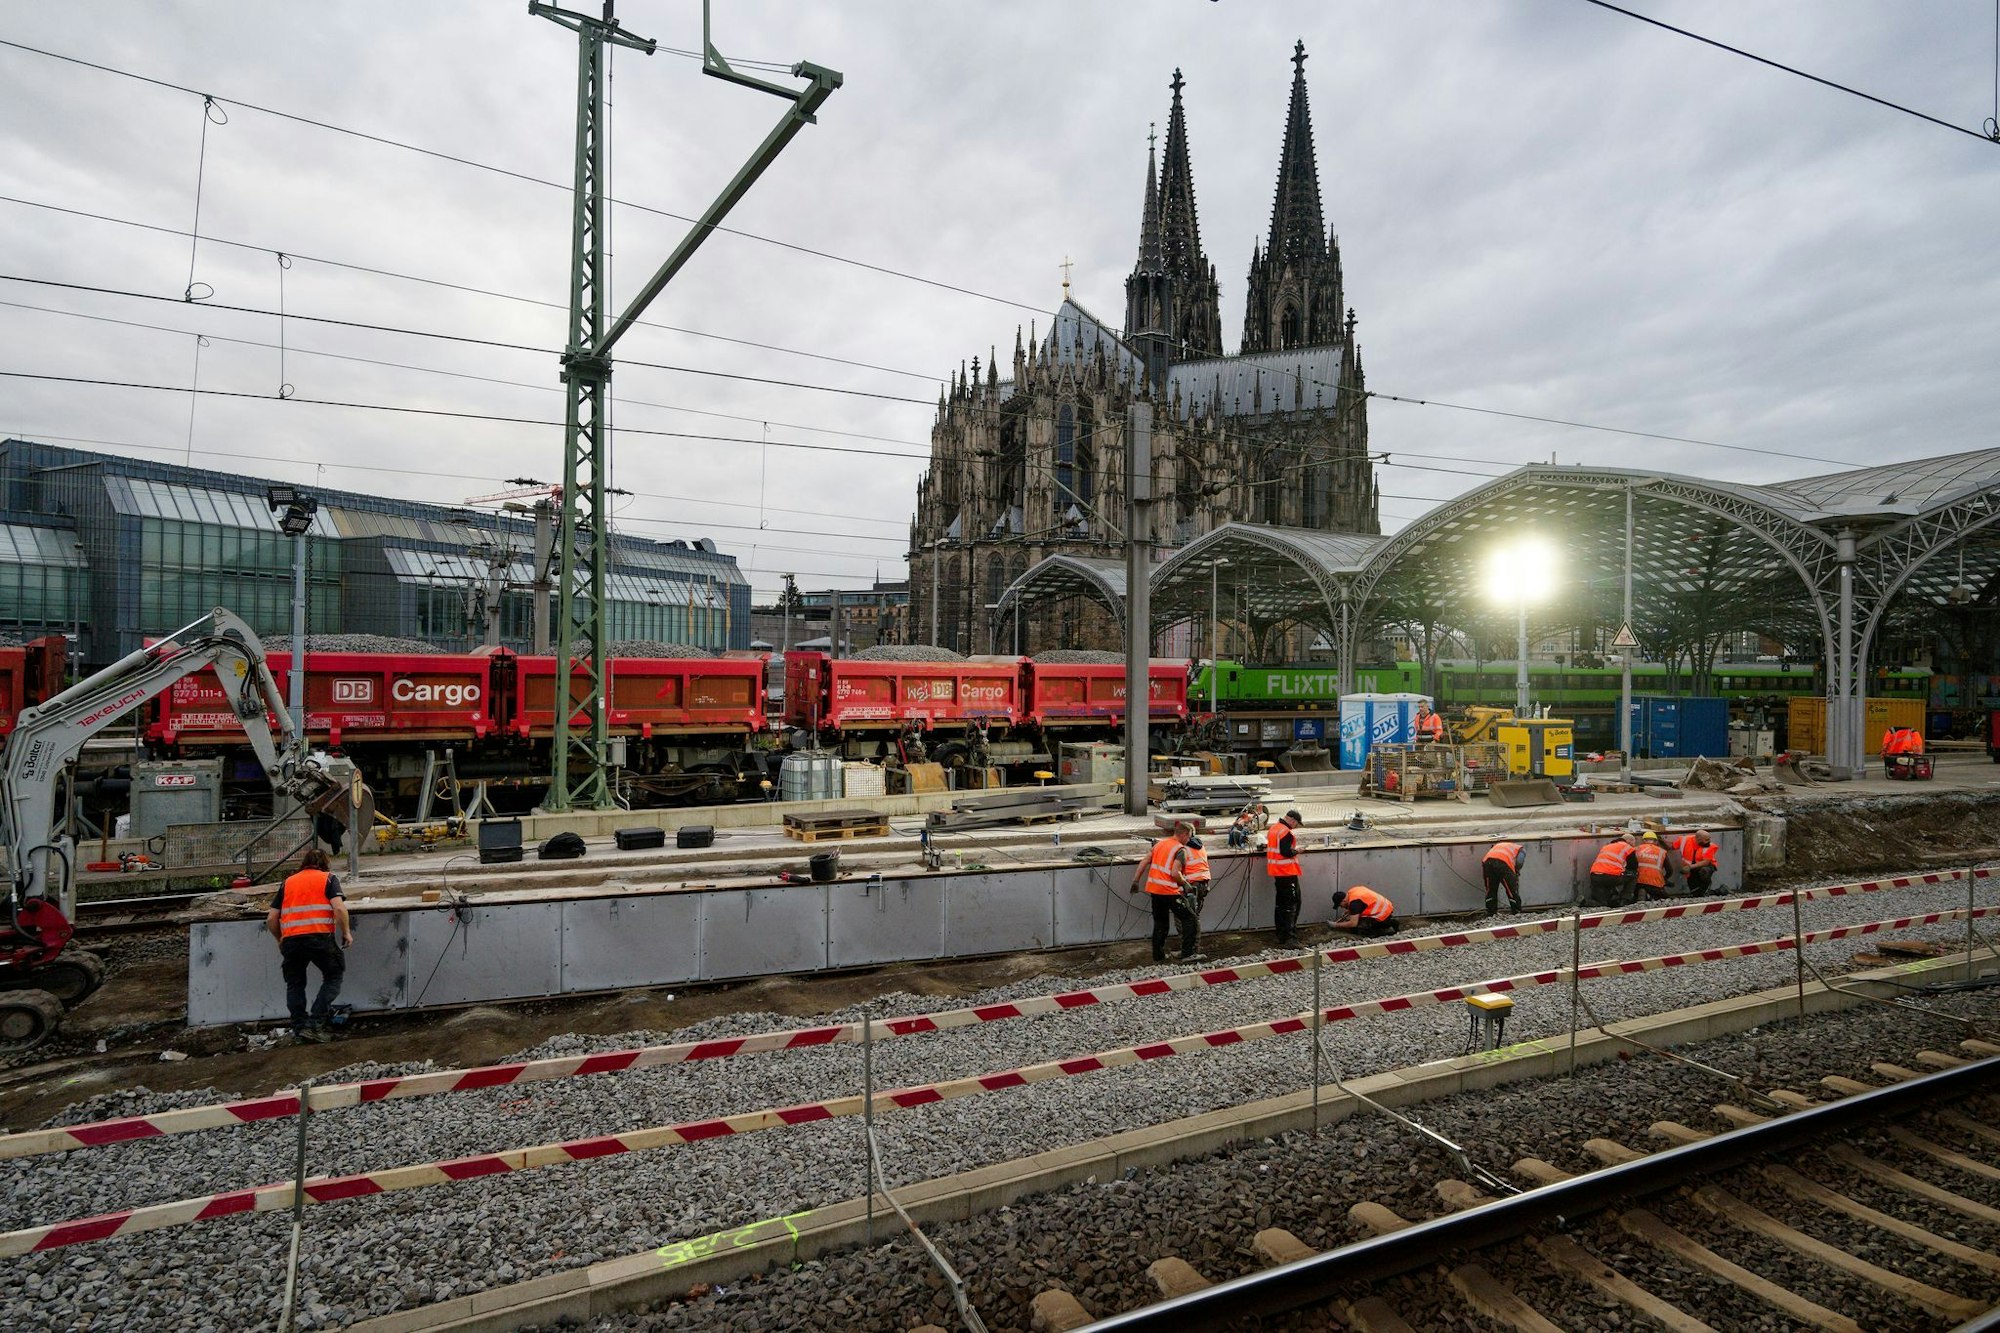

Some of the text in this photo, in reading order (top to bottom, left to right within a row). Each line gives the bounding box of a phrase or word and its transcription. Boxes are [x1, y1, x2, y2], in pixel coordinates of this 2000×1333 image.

[338, 679, 480, 706] DB Cargo
[961, 684, 1004, 700] Cargo
[1267, 675, 1377, 695] FLiXTRIN
[76, 689, 146, 727] TAKEUCHI
[24, 740, 42, 768] Balter
[1758, 834, 1772, 854] 7
